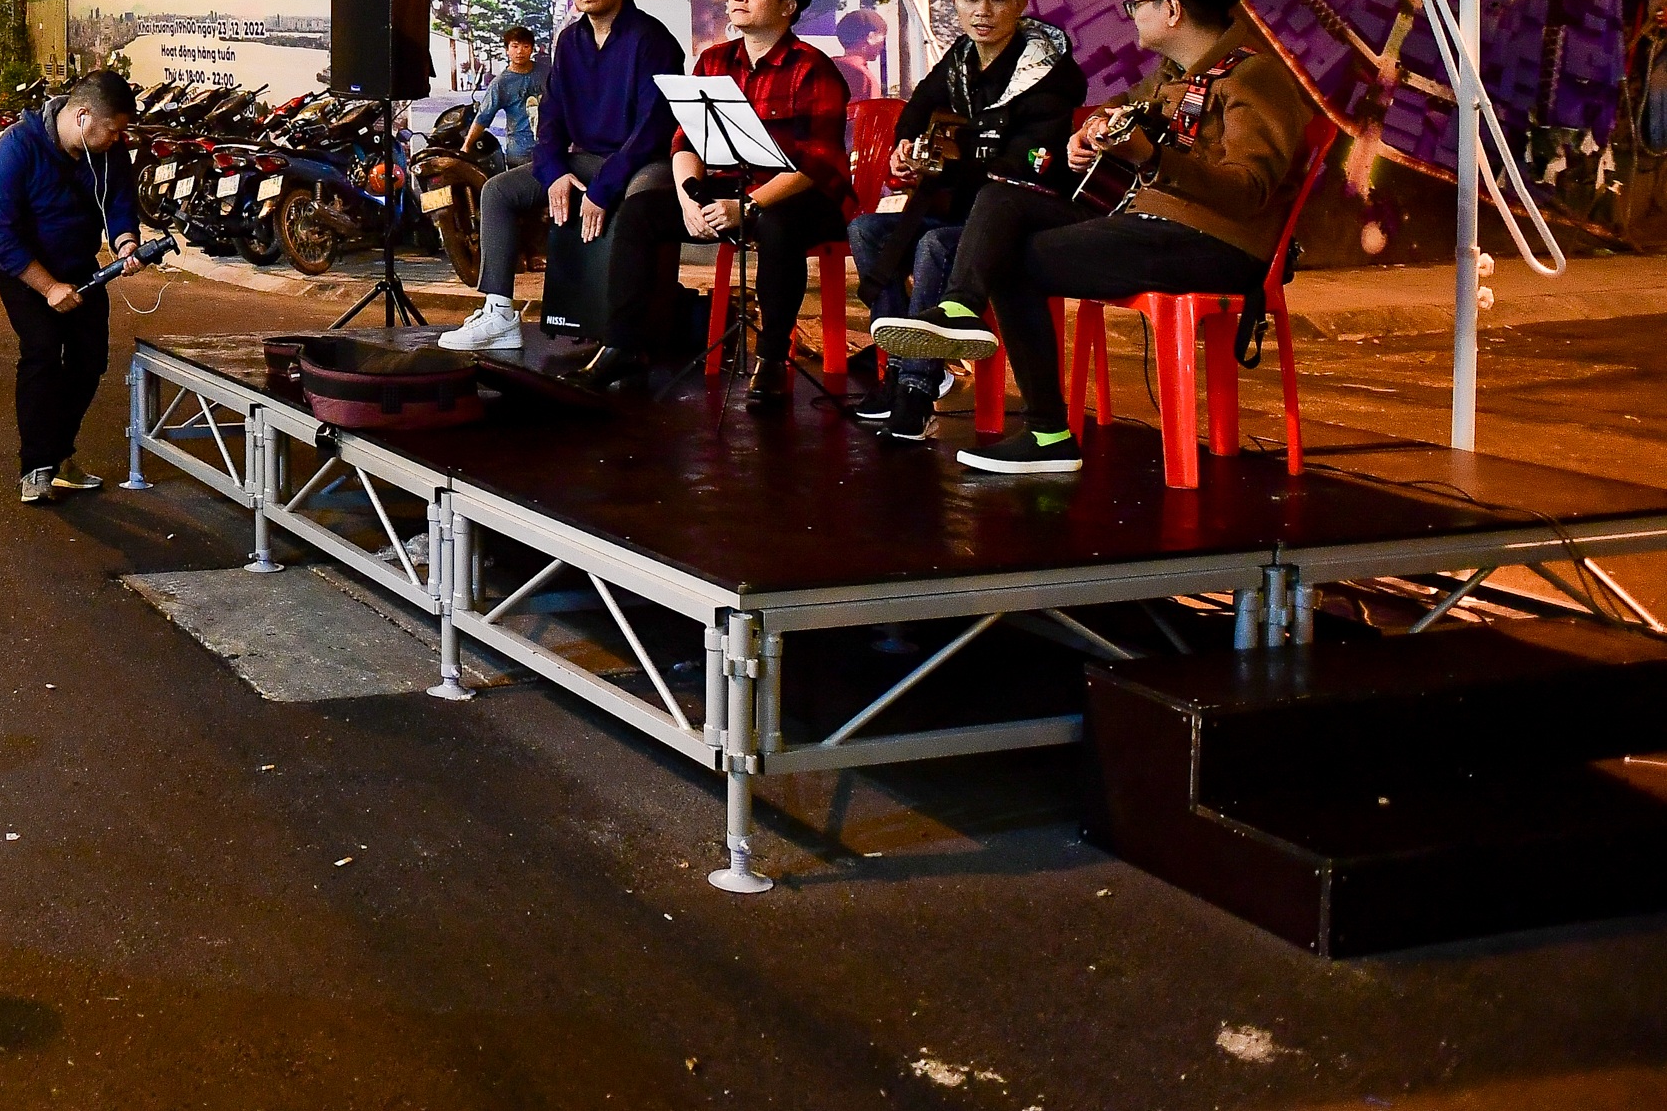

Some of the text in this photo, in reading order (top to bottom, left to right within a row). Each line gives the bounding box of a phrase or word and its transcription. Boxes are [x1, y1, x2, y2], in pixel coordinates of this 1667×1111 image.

[197, 20, 216, 38] ngày
[161, 44, 178, 61] Hoạt
[178, 44, 196, 62] động
[197, 45, 216, 64] hàng
[212, 72, 234, 88] 22:00
[546, 315, 566, 326] NISSI
